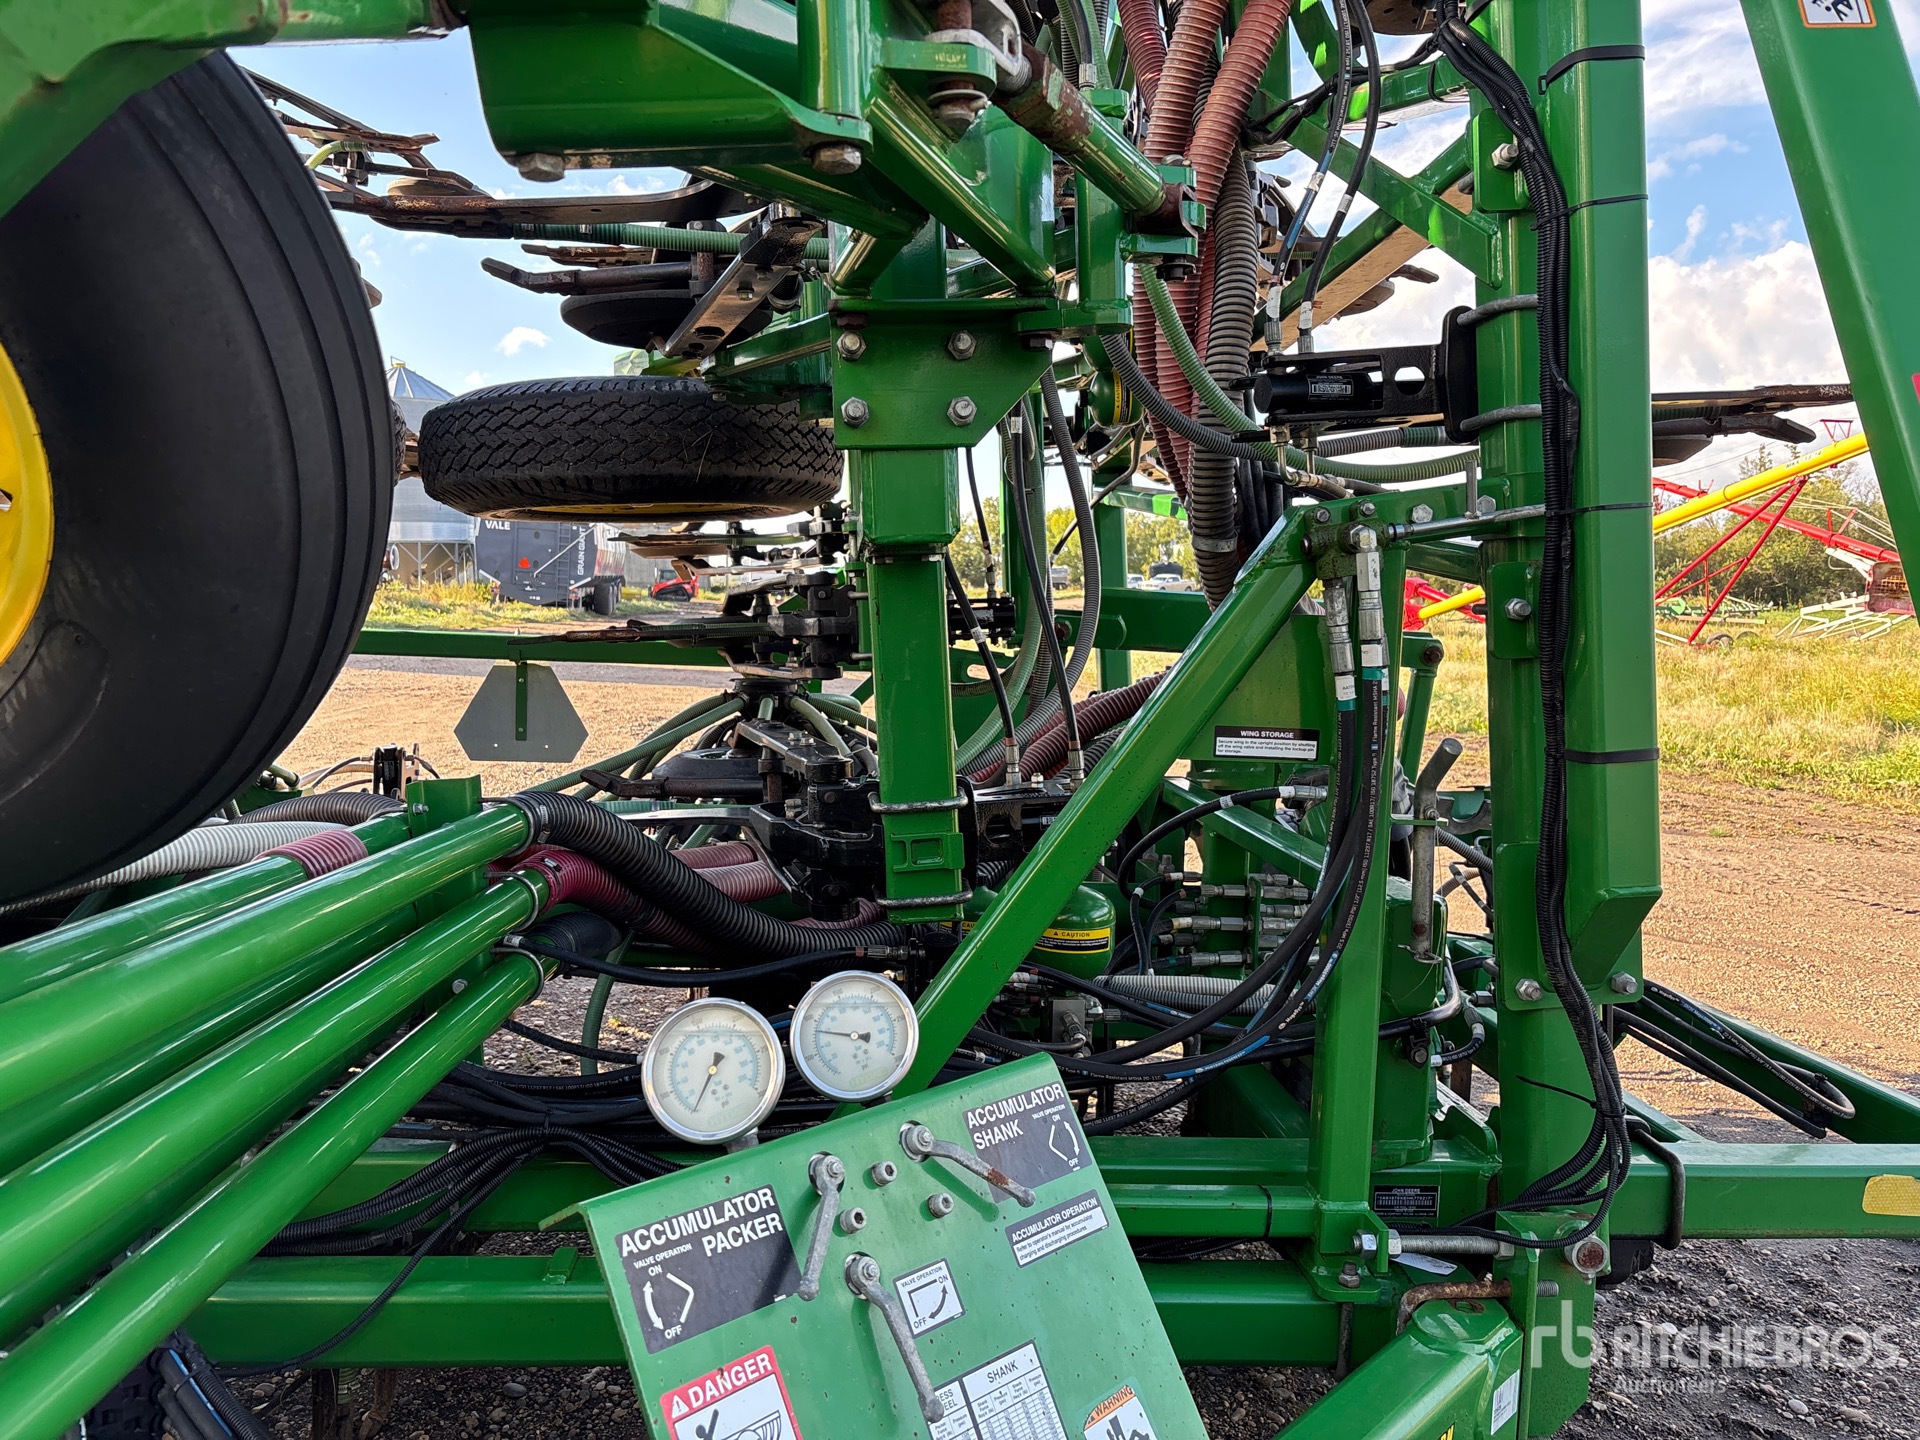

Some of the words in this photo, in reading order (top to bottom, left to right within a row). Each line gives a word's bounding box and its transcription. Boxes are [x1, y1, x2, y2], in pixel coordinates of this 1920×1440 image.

[485, 520, 511, 530] VALE
[577, 551, 585, 576] GRAIN
[967, 1083, 1064, 1129] ACCUMULATOR
[1032, 1111, 1045, 1120] VALVE
[1044, 1104, 1066, 1116] OPERATION
[1052, 1113, 1061, 1122] ON
[973, 1119, 1023, 1150] SHANK
[1068, 1157, 1079, 1167] OFF
[622, 1187, 776, 1257] ACCUMULATOR
[1011, 1213, 1062, 1243] ACCUMULATOR
[1062, 1197, 1098, 1220] OPERATION
[702, 1212, 783, 1257] PACKER
[1016, 1242, 1028, 1251] Refer
[1032, 1232, 1052, 1247] operator's
[1051, 1226, 1065, 1237] manual
[1070, 1214, 1093, 1228] accumulator
[1019, 1248, 1037, 1261] charging
[1037, 1244, 1045, 1252] and
[1044, 1234, 1067, 1250] discharging
[1066, 1225, 1087, 1240] procedures
[633, 1255, 655, 1269] VALVE
[656, 1243, 693, 1262] OPERATION
[648, 1264, 662, 1277] ON
[901, 1276, 916, 1288] VALVE
[916, 1265, 943, 1280] OPERATION
[938, 1274, 949, 1284] ON
[664, 1324, 682, 1339] OFF
[913, 1317, 927, 1329] OFF
[688, 1353, 772, 1409] DANGER
[987, 1360, 1019, 1384] SHANK
[936, 1388, 954, 1401] ESS
[943, 1398, 958, 1410] EEL
[1094, 1385, 1133, 1417] WARNING
